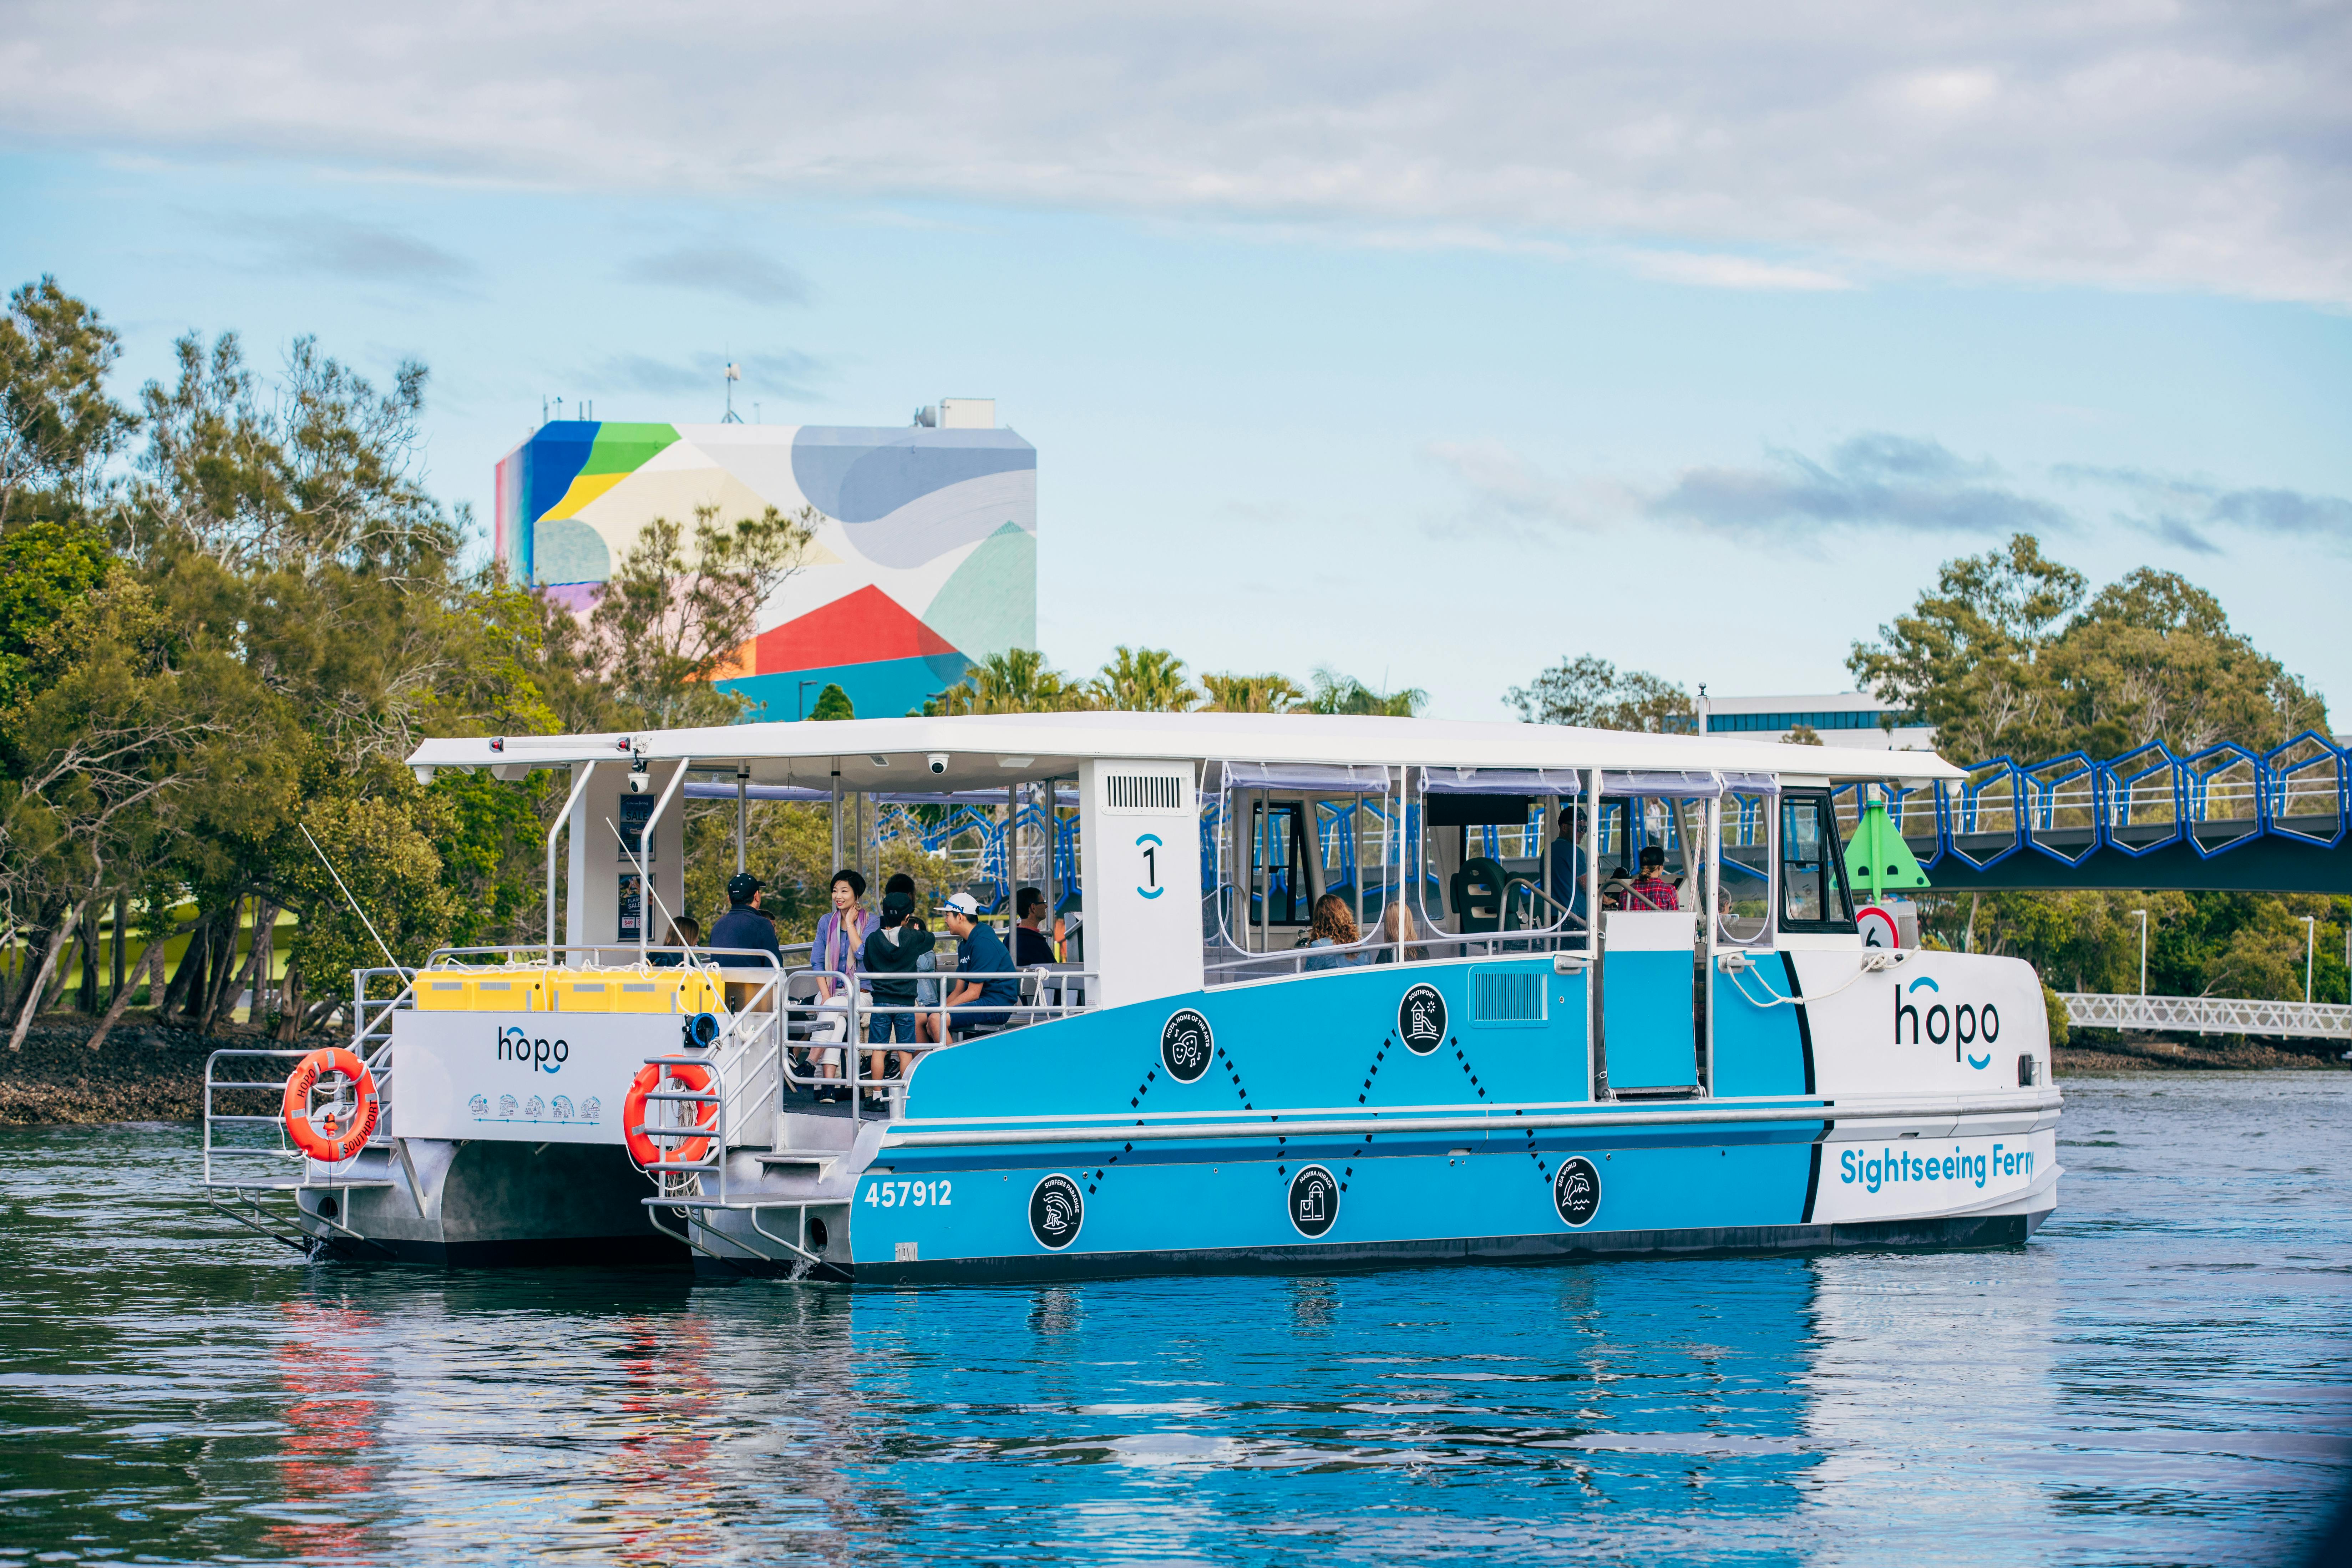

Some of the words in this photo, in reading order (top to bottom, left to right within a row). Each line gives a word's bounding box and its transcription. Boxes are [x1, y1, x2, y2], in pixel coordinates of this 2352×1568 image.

[626, 811, 648, 821] SALE
[1143, 846, 1155, 887] 1
[1409, 989, 1435, 1001] SOUTHPORT
[1176, 1014, 1191, 1023] HOME
[1196, 1019, 1206, 1032] THE
[1895, 984, 1999, 1062] hopo
[498, 1026, 569, 1072] hopo
[297, 1069, 315, 1098] HOPO
[343, 1100, 377, 1154] SOUTHPORT
[1299, 1170, 1317, 1184] MARINA
[1317, 1171, 1333, 1189] MIRAGE
[1562, 1162, 1577, 1176] WORLD
[1840, 1146, 1986, 1193] Sightseeing
[1993, 1144, 2034, 1183] Ferry
[864, 1180, 952, 1208] 457912
[1044, 1179, 1066, 1188] SURFERS
[1066, 1184, 1079, 1213] PARADISE
